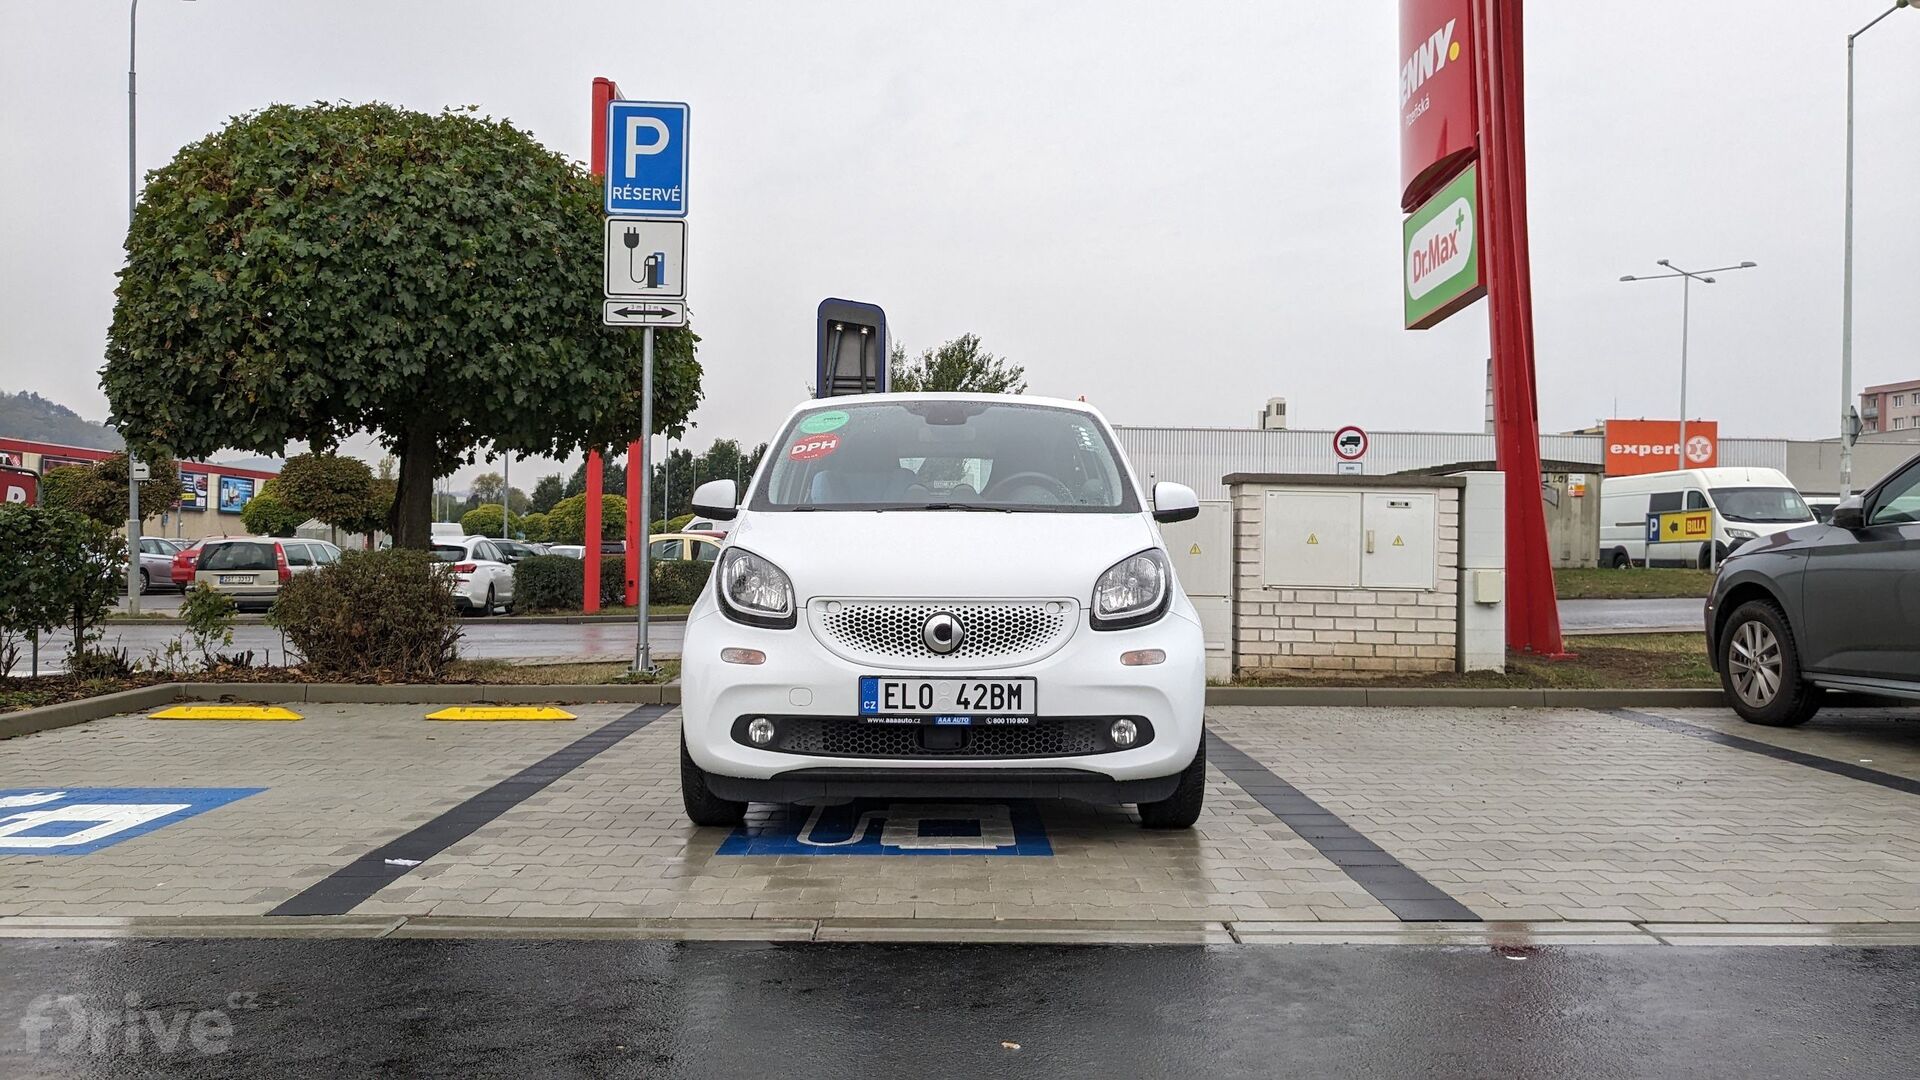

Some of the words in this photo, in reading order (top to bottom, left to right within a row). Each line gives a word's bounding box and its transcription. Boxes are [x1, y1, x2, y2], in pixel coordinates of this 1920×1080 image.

[625, 115, 670, 179] P
[612, 184, 681, 202] RÉSERVÉ
[1412, 228, 1458, 284] Dr.Max
[791, 440, 837, 455] DPH
[1610, 443, 1681, 456] expert
[1649, 518, 1658, 539] P
[1686, 517, 1706, 533] BILLA
[863, 701, 876, 710] CZ
[956, 683, 1022, 710] 42BM
